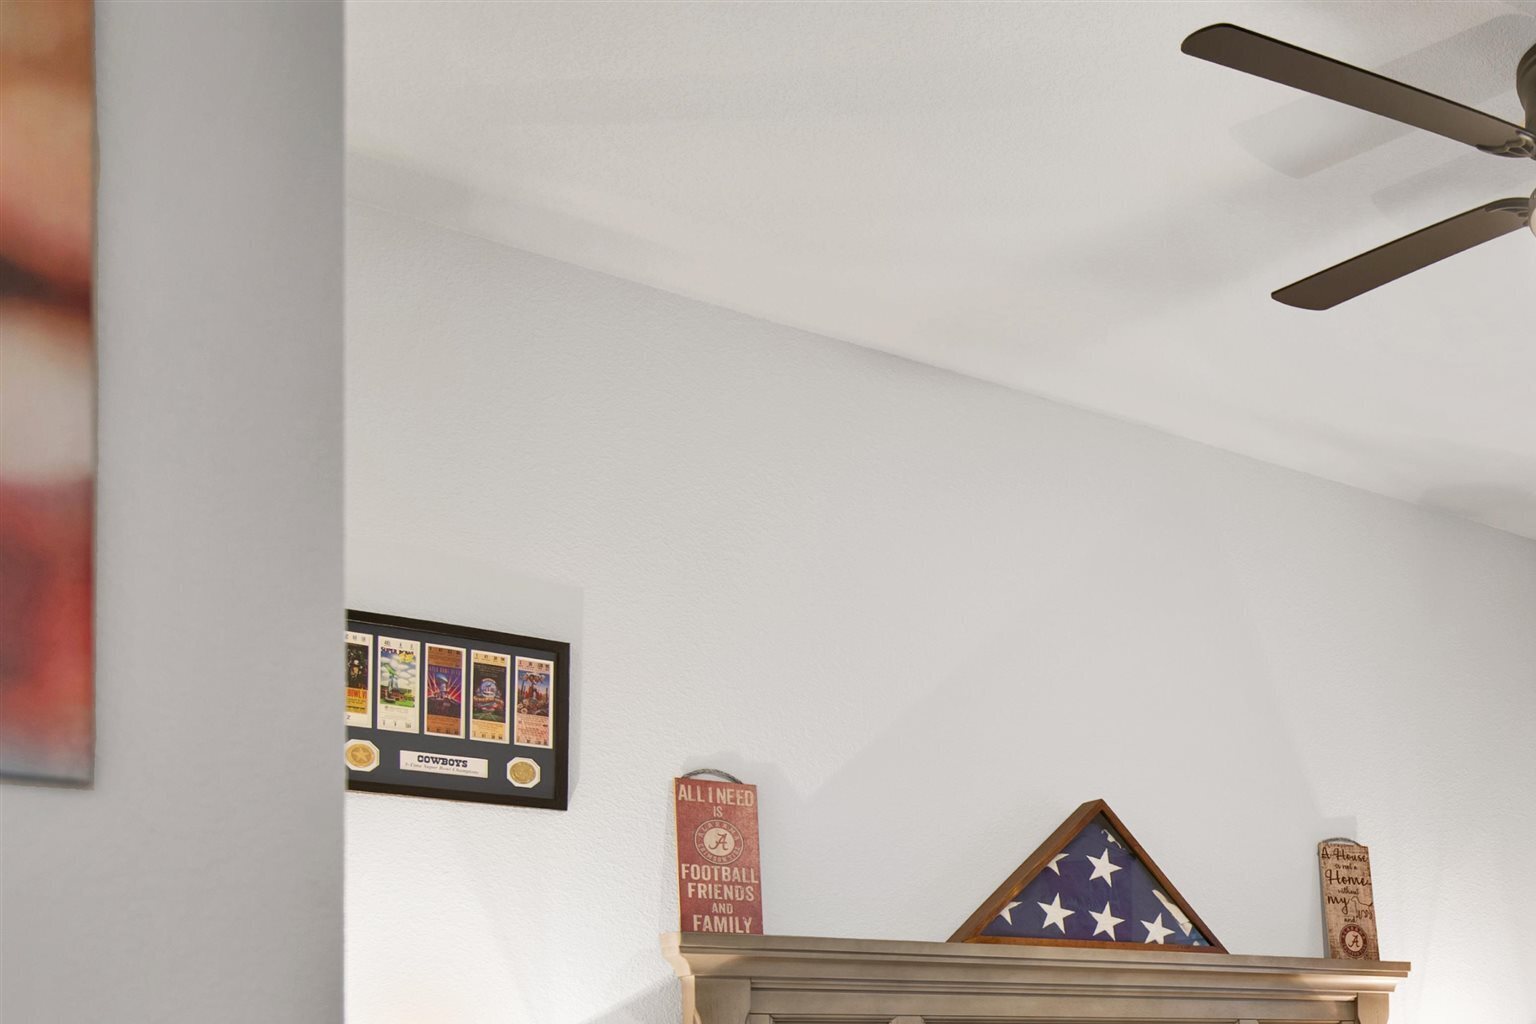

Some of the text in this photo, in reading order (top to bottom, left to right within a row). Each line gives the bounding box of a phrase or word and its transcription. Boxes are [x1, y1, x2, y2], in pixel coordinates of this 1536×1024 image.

[417, 755, 468, 768] COWBOYS
[678, 784, 754, 807] ALL I NEED
[713, 806, 723, 818] IS
[1333, 848, 1368, 862] House
[681, 864, 759, 884] FOOTBALL
[1325, 869, 1371, 886] Home
[687, 883, 754, 902] FRIENDS
[712, 903, 733, 915] AND
[693, 914, 752, 934] FAMILY
